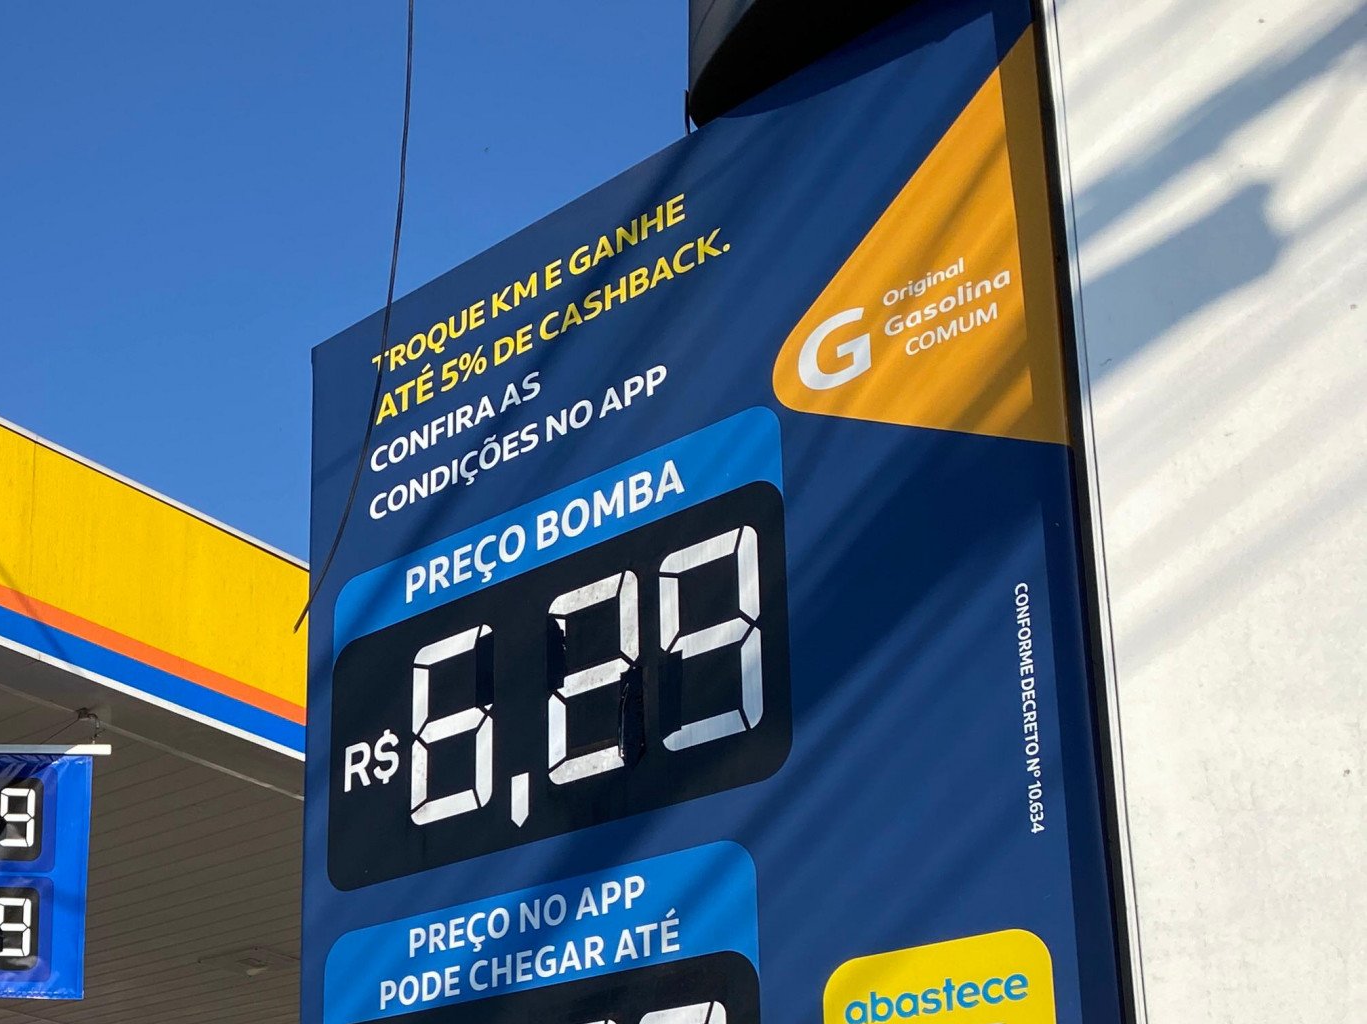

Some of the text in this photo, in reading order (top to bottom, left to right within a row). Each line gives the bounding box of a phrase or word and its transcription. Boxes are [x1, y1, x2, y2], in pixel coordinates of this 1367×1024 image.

[372, 193, 686, 373] TROQUE KM E GANHE
[375, 227, 731, 425] ATÉ 5% DE CASHBACK.
[883, 257, 964, 306] Original
[884, 270, 1011, 337] Gasolina
[905, 302, 998, 356] COMUM
[798, 307, 871, 390] G
[370, 372, 541, 473] CONFIRA AS
[370, 364, 667, 521] CONDIÇÕES NO APP
[405, 459, 685, 604] PREÇO BOMBA
[344, 524, 764, 828] R$ 6,29
[1014, 582, 1034, 677] CONFORME
[1021, 677, 1040, 756] DECRETO
[1027, 780, 1044, 834] 10.634
[380, 908, 681, 1010] PODE CHEGAR ATÉ
[409, 875, 646, 958] PREÇO NO APP
